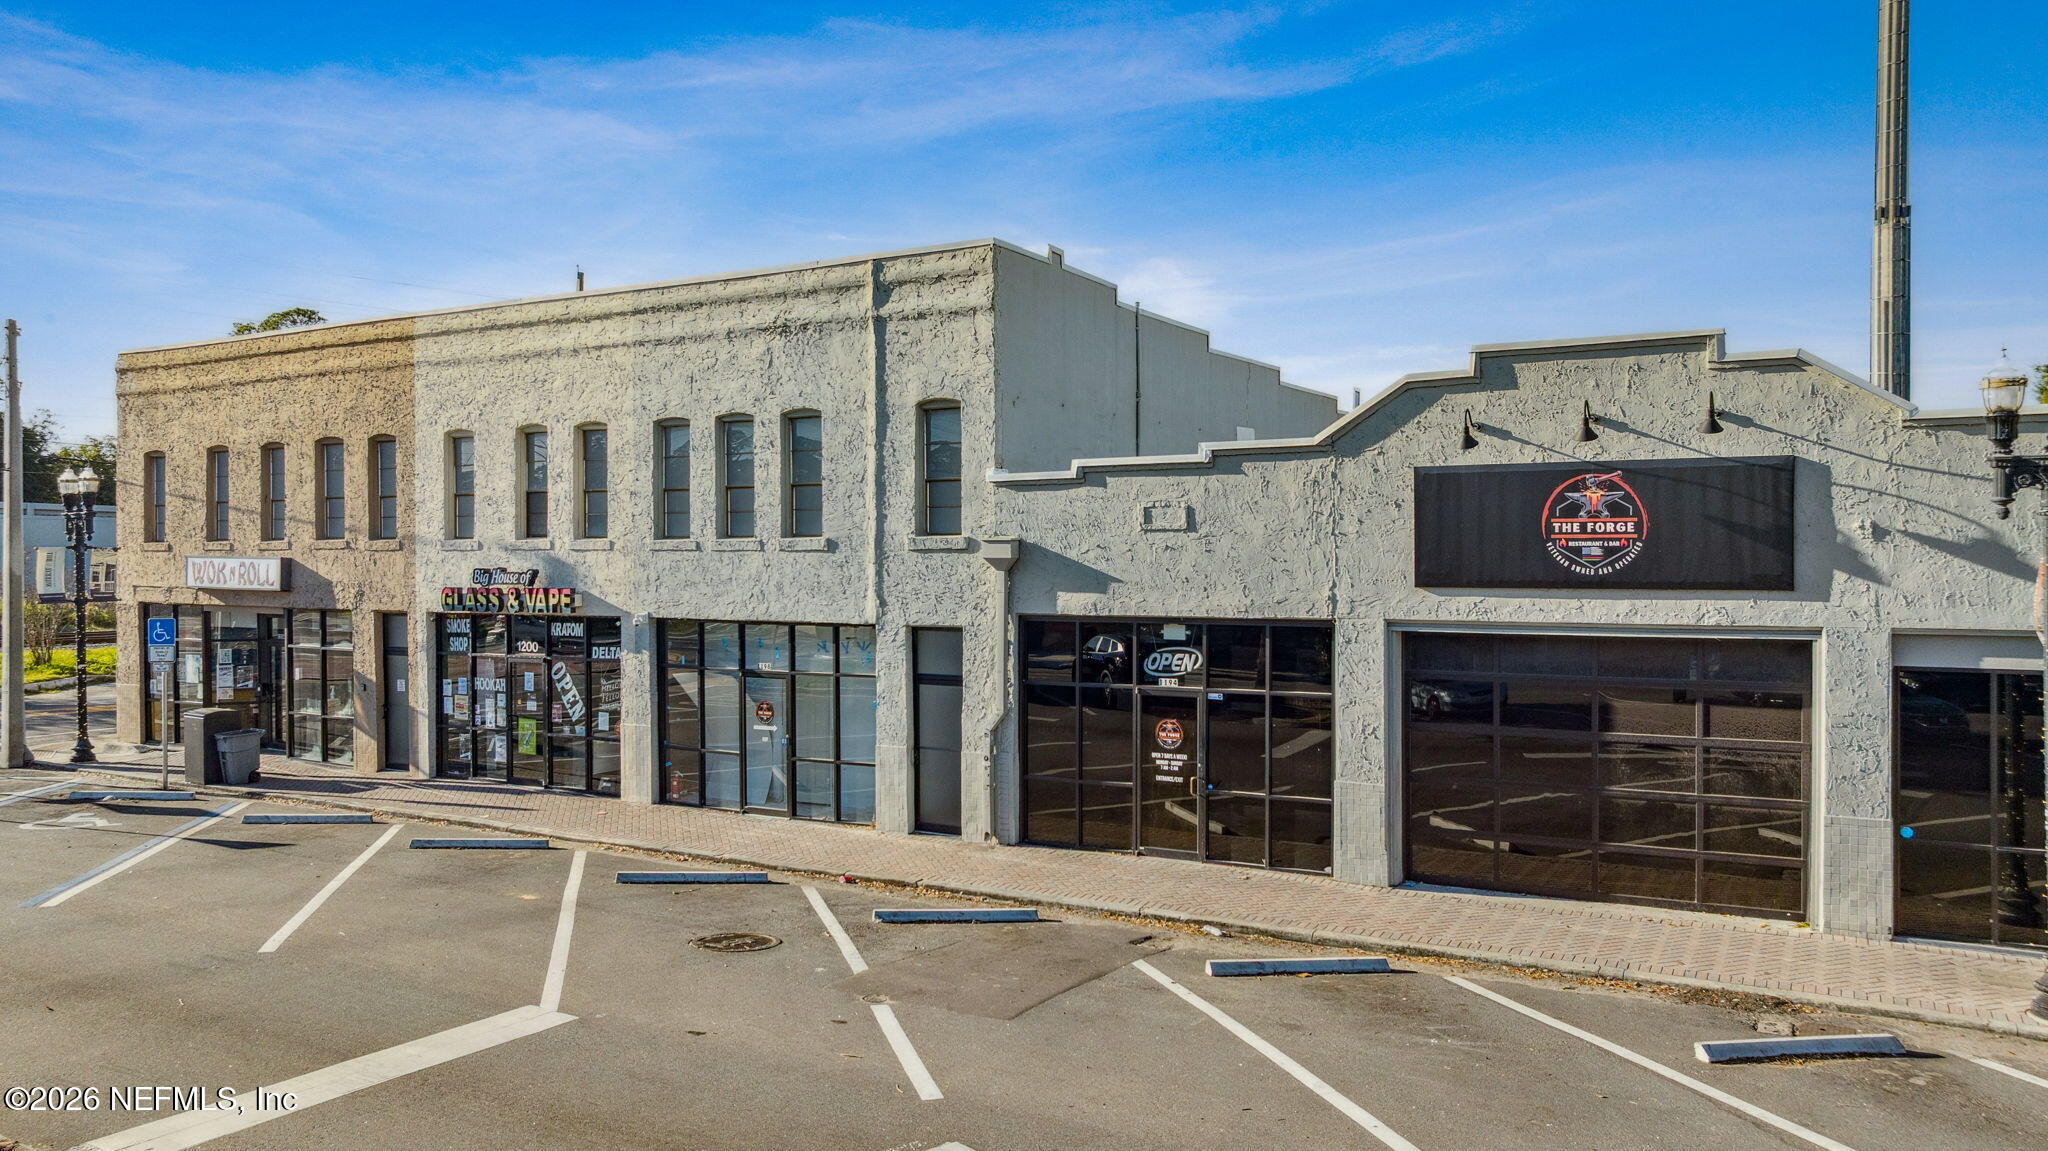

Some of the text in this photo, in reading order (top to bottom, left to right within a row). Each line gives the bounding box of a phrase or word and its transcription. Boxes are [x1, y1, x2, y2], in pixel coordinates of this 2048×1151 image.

[1553, 522, 1635, 533] THE FORGE
[1546, 541, 1643, 575] VETERAN OWNED AND OPERATED
[192, 560, 228, 585] WOK
[238, 561, 275, 586] ROLL
[473, 569, 534, 586] Big House of
[441, 587, 573, 613] GLASS & VAPE
[447, 618, 471, 633] SMOKE
[551, 622, 584, 637] KRATOM
[450, 636, 468, 651] SHOP
[517, 641, 539, 652] 1200
[592, 646, 621, 659] DELTA
[1147, 652, 1197, 672] OPEN
[475, 677, 506, 692] HOOKAH
[551, 661, 586, 722] OPEN
